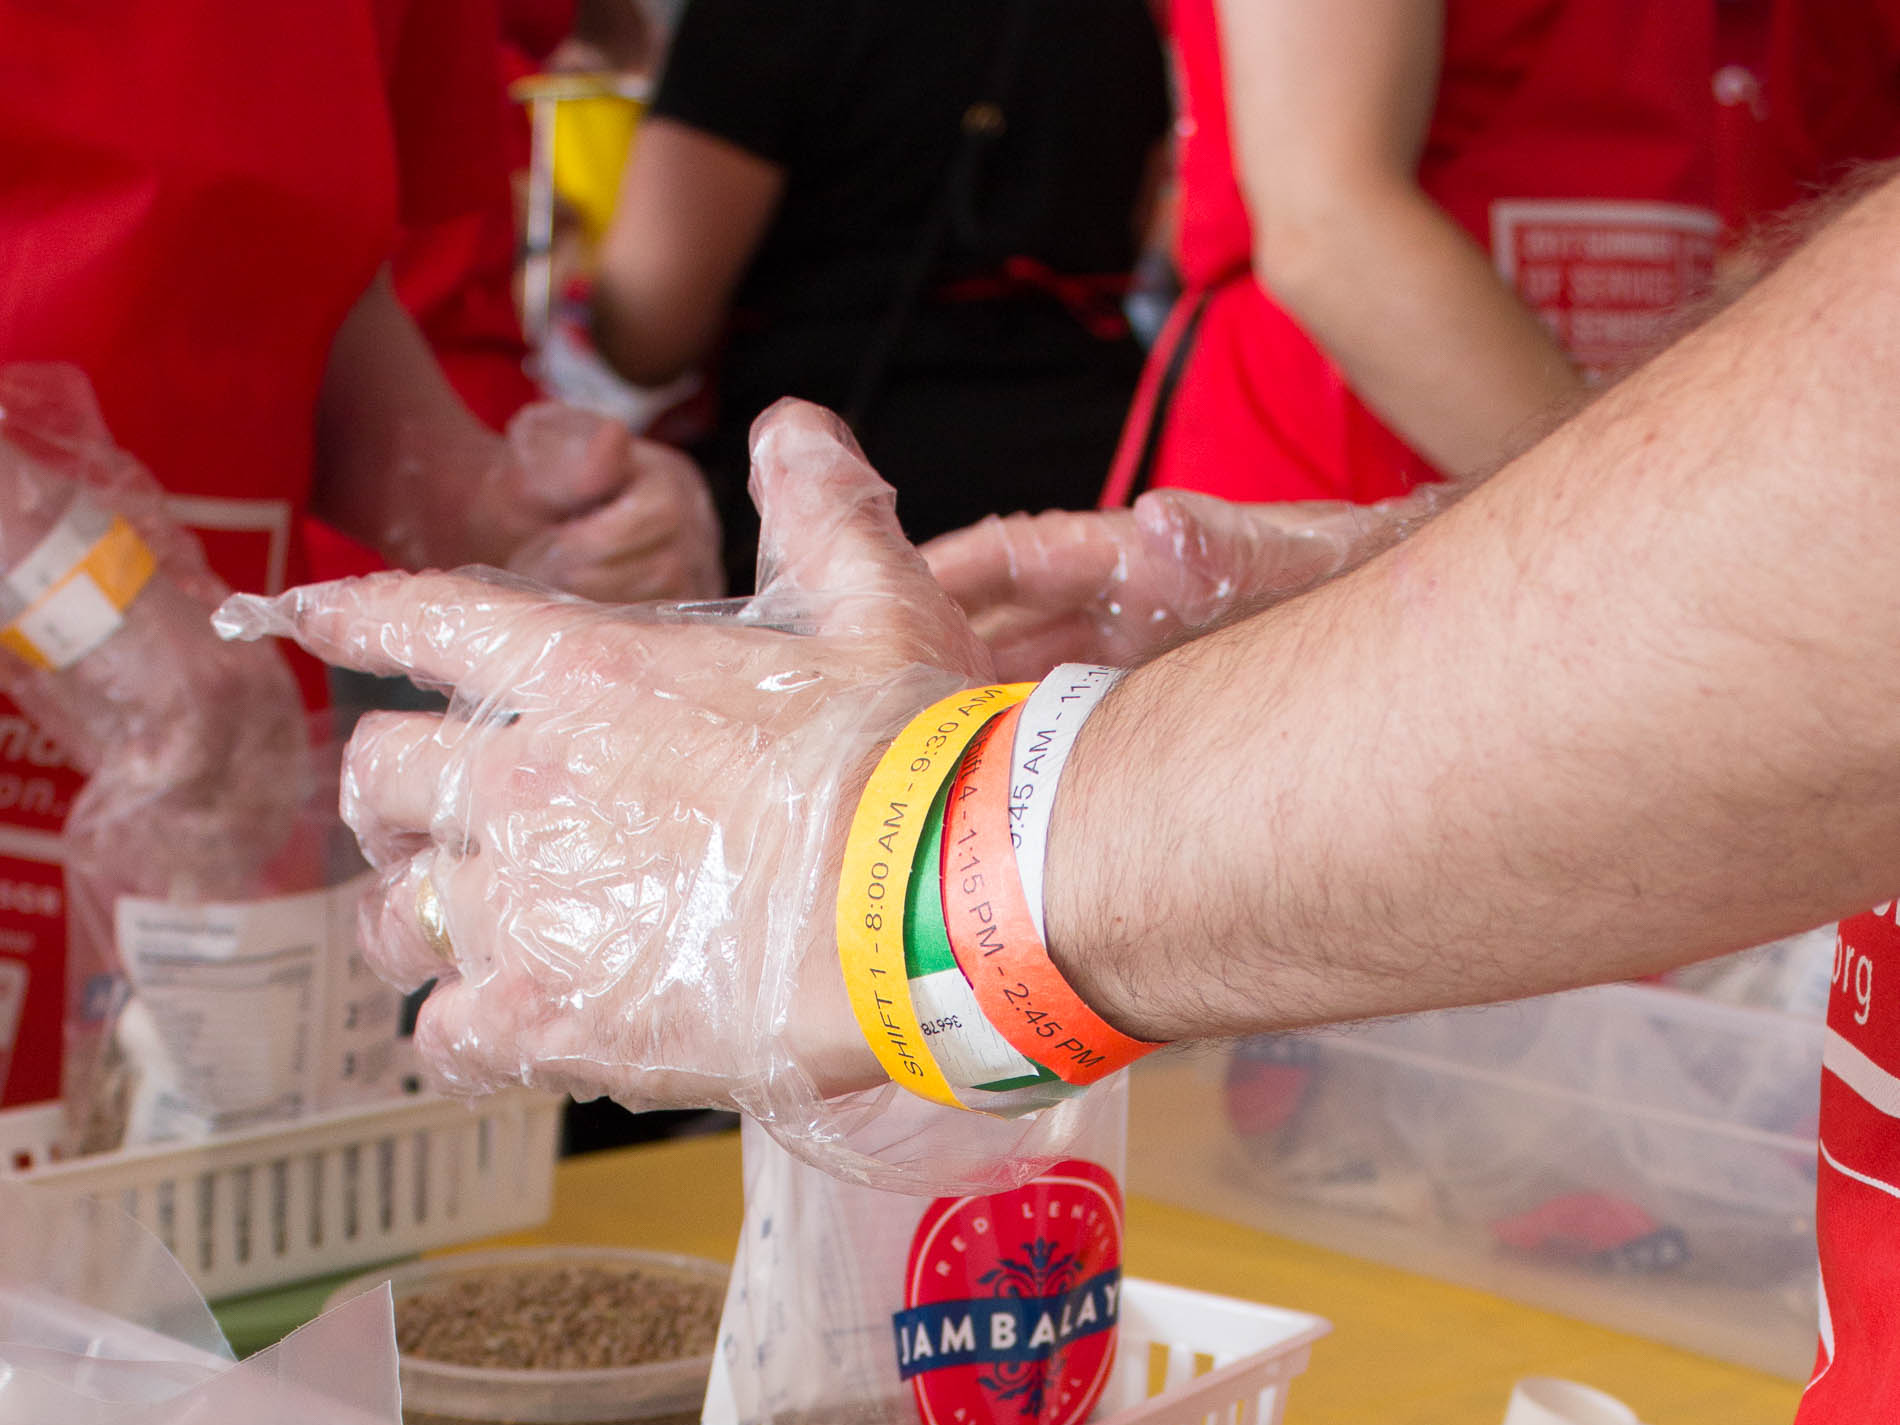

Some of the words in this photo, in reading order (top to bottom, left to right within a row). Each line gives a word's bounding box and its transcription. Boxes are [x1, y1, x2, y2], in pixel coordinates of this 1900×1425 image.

[958, 688, 1003, 717] AM
[910, 722, 959, 773] 9:30
[1023, 729, 1056, 774] AM
[958, 785, 978, 801] 4
[878, 802, 908, 853] AM
[957, 829, 985, 894] 1:15
[865, 862, 889, 930] 8:00
[969, 901, 1005, 957] PM
[869, 967, 887, 978] 1
[874, 989, 924, 1077] SHIFT
[920, 1014, 963, 1037] 36678
[1003, 982, 1063, 1038] 2:45
[1054, 1037, 1106, 1069] PM
[934, 1216, 989, 1278] RED
